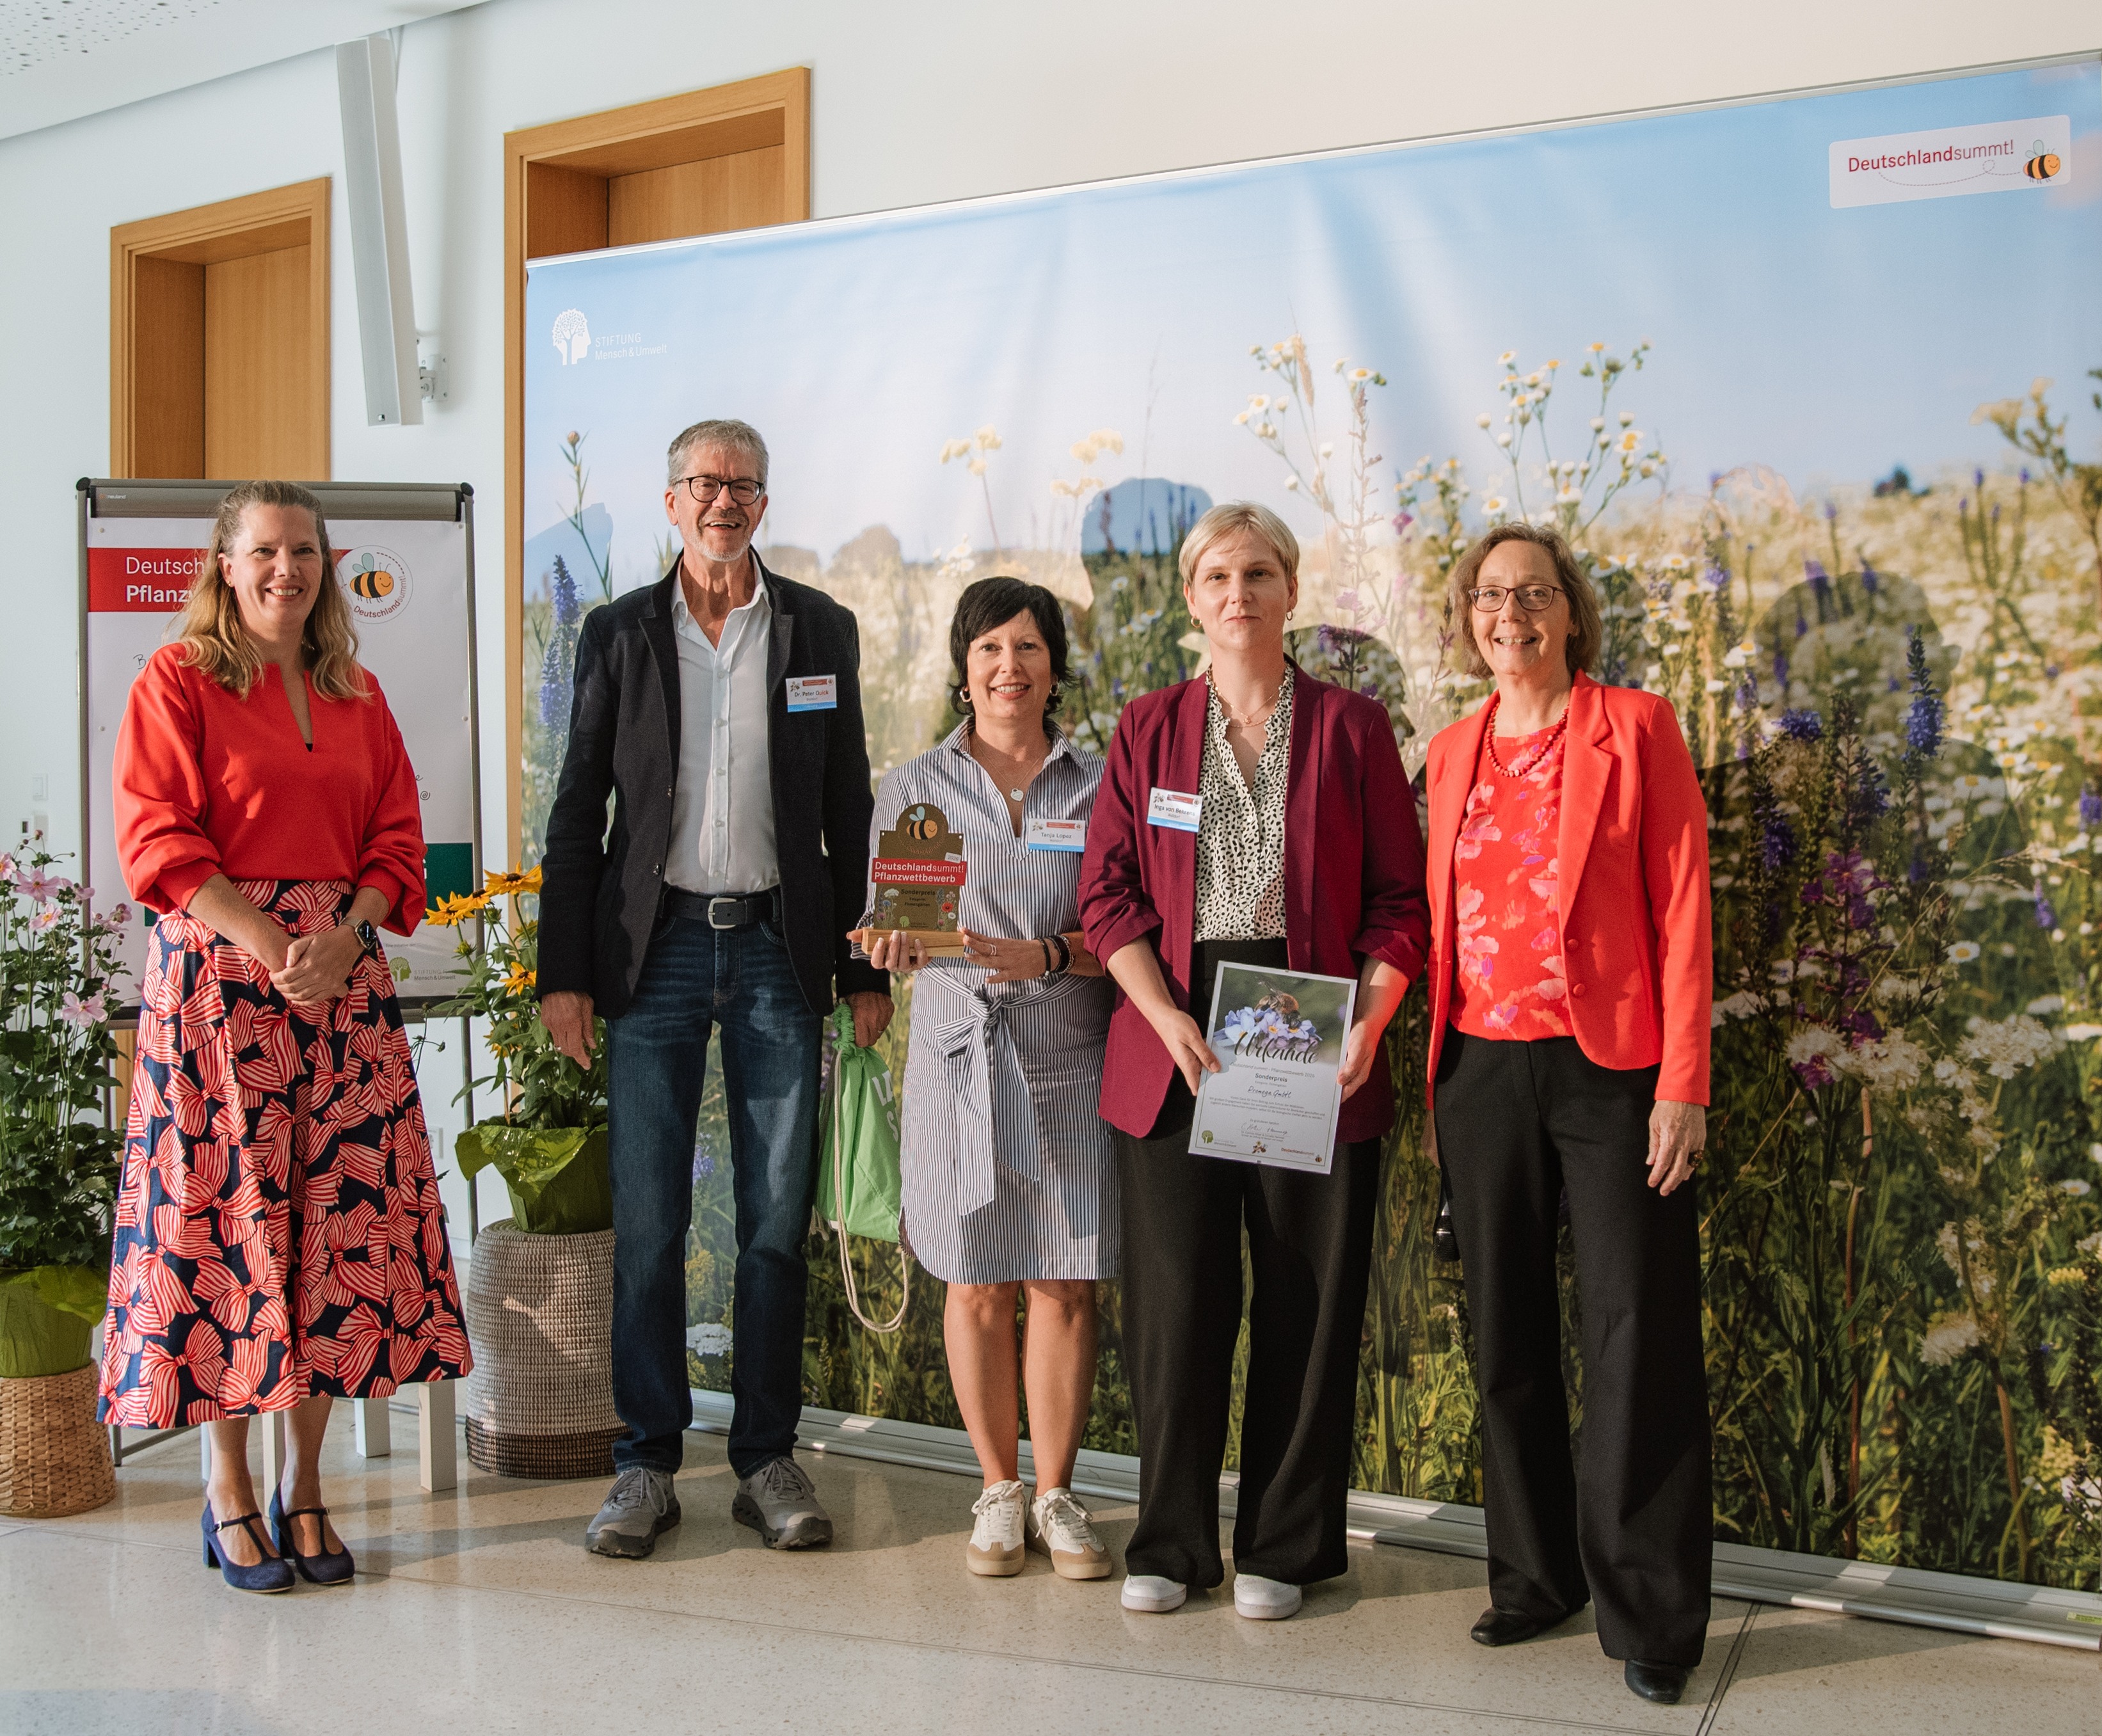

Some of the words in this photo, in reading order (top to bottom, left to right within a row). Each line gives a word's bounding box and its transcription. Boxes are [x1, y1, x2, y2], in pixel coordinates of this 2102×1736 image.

[1848, 139, 2014, 172] Deutschlandsummt!
[595, 332, 641, 348] STIFTUNG
[595, 347, 627, 360] Mensch
[628, 348, 635, 358] &
[635, 344, 667, 357] Umwelt
[1175, 808, 1196, 816] Behrens
[875, 861, 964, 873] Deutschlandsummt!
[874, 872, 956, 882] Pflanzwettbewerb
[1234, 1031, 1319, 1065] Urkunde
[1255, 1072, 1287, 1083] Sonderpreis
